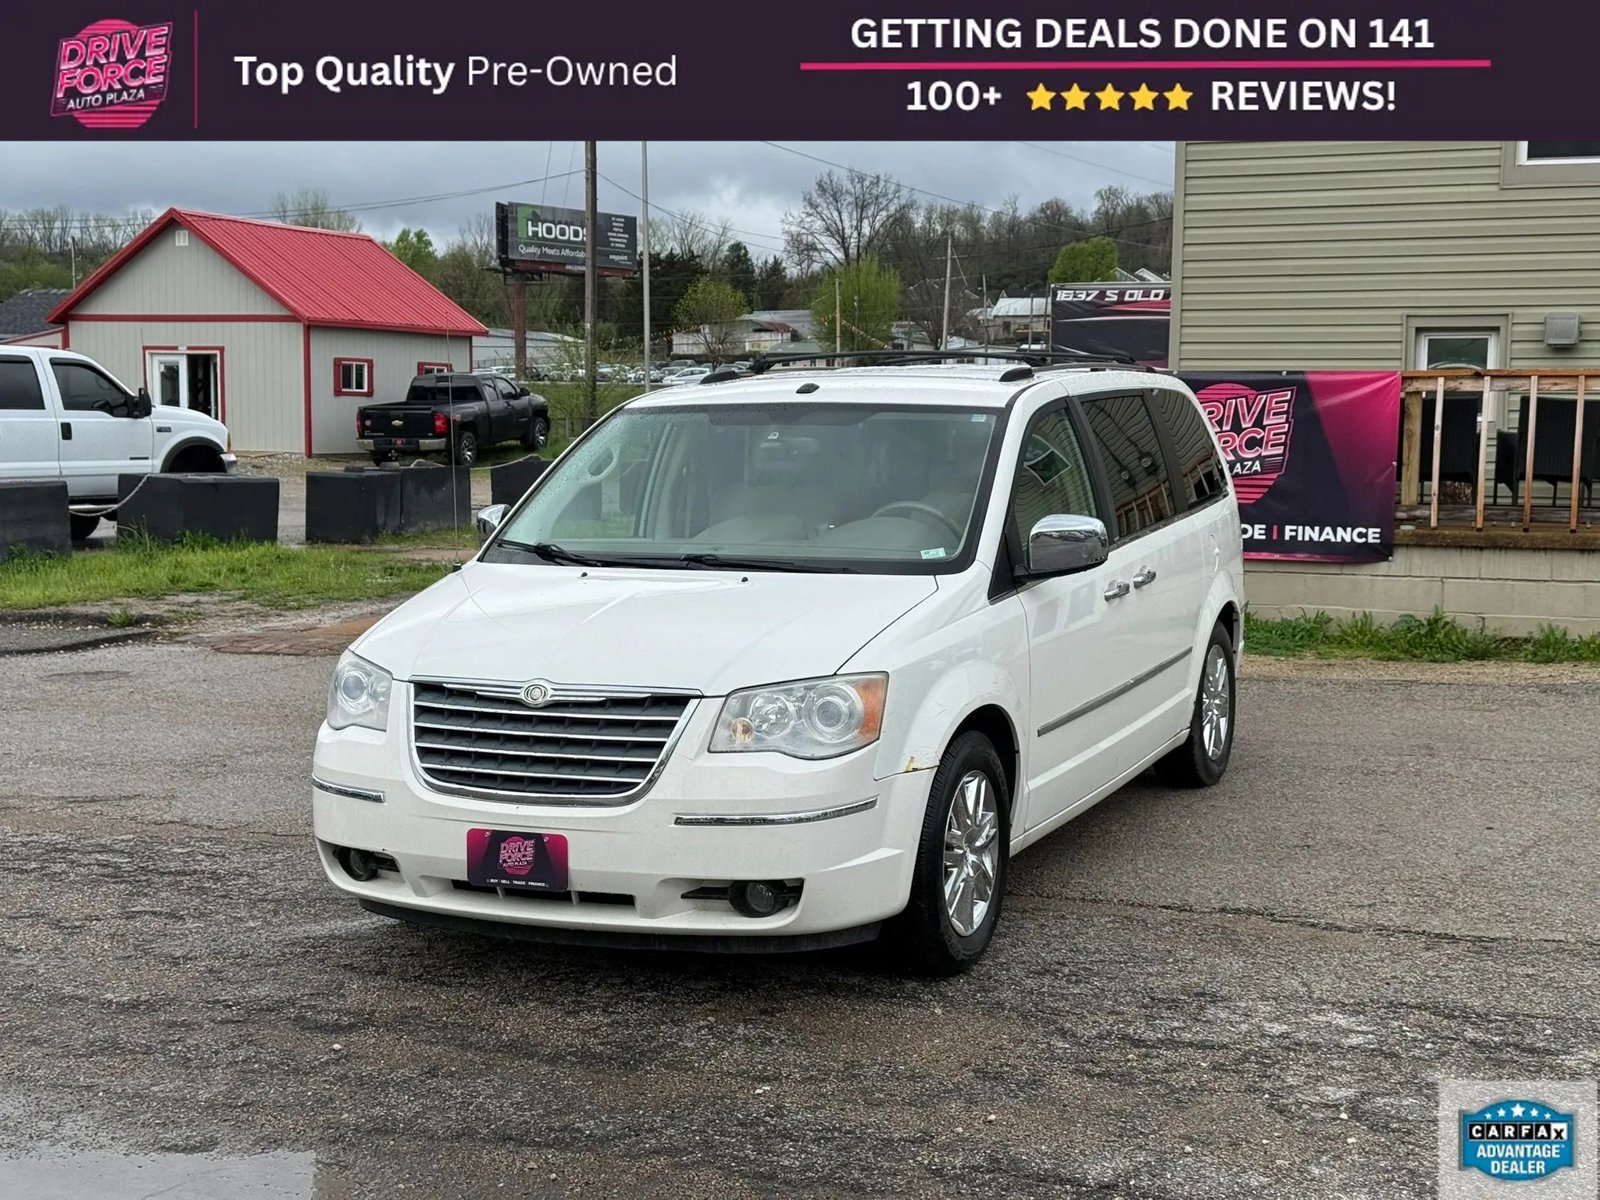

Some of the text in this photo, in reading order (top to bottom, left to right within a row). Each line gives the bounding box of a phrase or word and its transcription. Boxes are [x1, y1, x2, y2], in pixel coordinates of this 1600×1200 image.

[527, 220, 586, 241] HOOD
[518, 243, 586, 257] Quality Meets Affordab
[1056, 289, 1165, 301] 1637 S OLD
[1200, 390, 1293, 433] RIVE
[1216, 423, 1290, 461] RCE
[1241, 523, 1381, 544] DE FINANCE
[500, 840, 535, 853] DRIVE
[499, 851, 534, 863] FORCE
